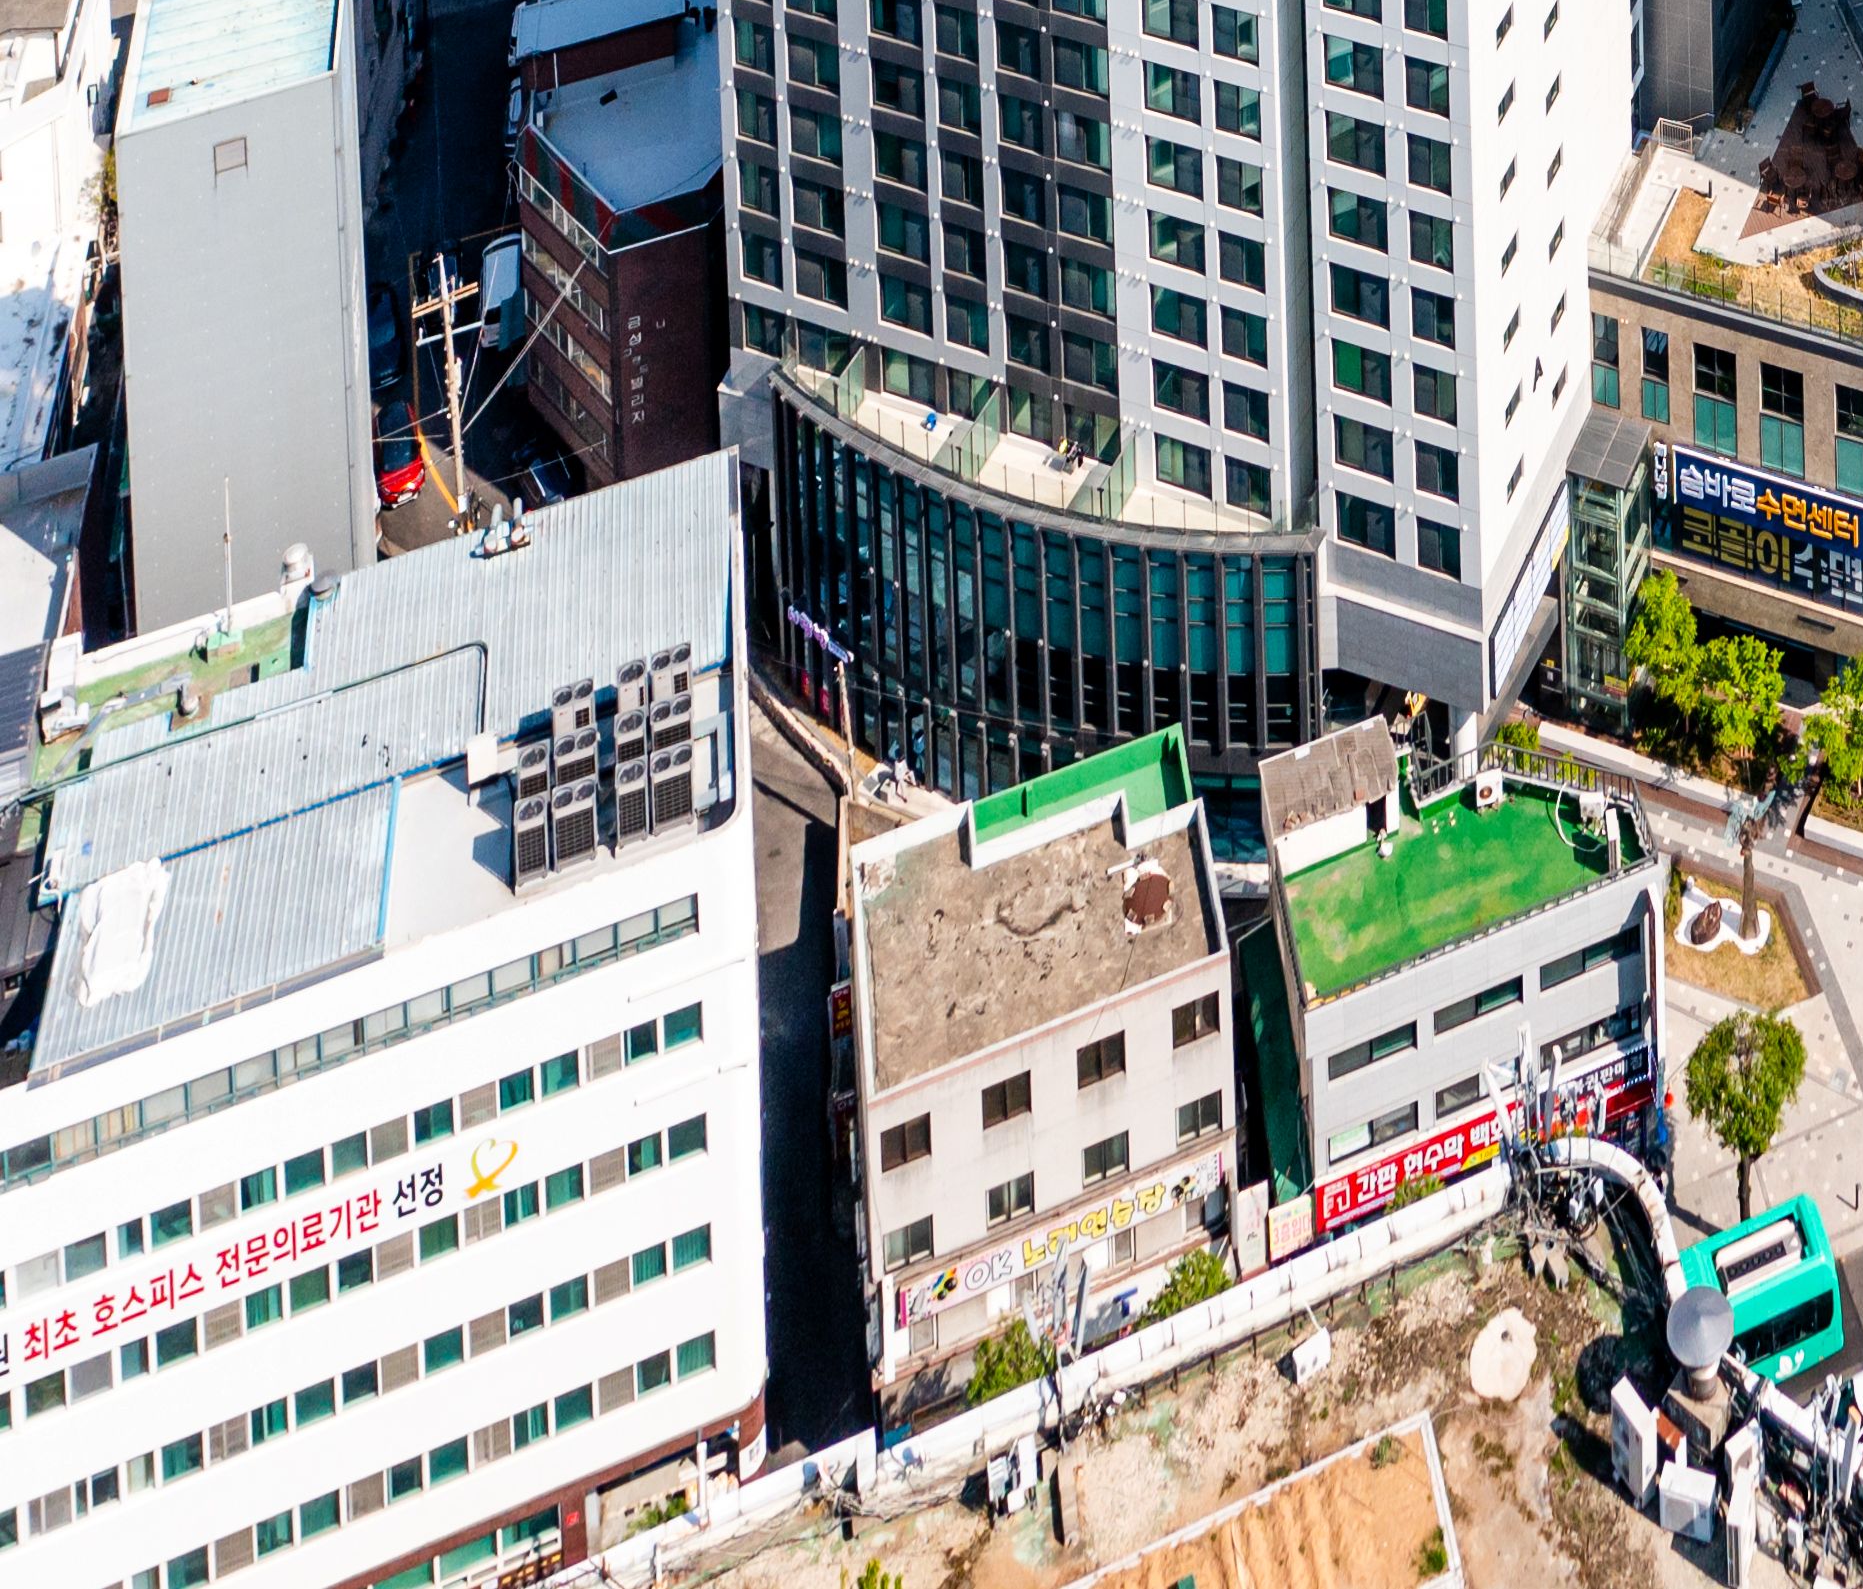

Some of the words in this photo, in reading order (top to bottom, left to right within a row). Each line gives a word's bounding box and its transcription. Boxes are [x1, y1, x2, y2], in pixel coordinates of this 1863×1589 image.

[1682, 505, 1791, 583] 코골이
[1357, 1162, 1398, 1203] 간판
[1403, 1132, 1465, 1181] 현수막
[23, 1310, 81, 1362] 최초
[91, 1262, 205, 1338] 호스피스
[215, 1188, 382, 1289] 전문의료기관
[392, 1163, 444, 1218] 선정
[965, 1249, 1013, 1291] OK
